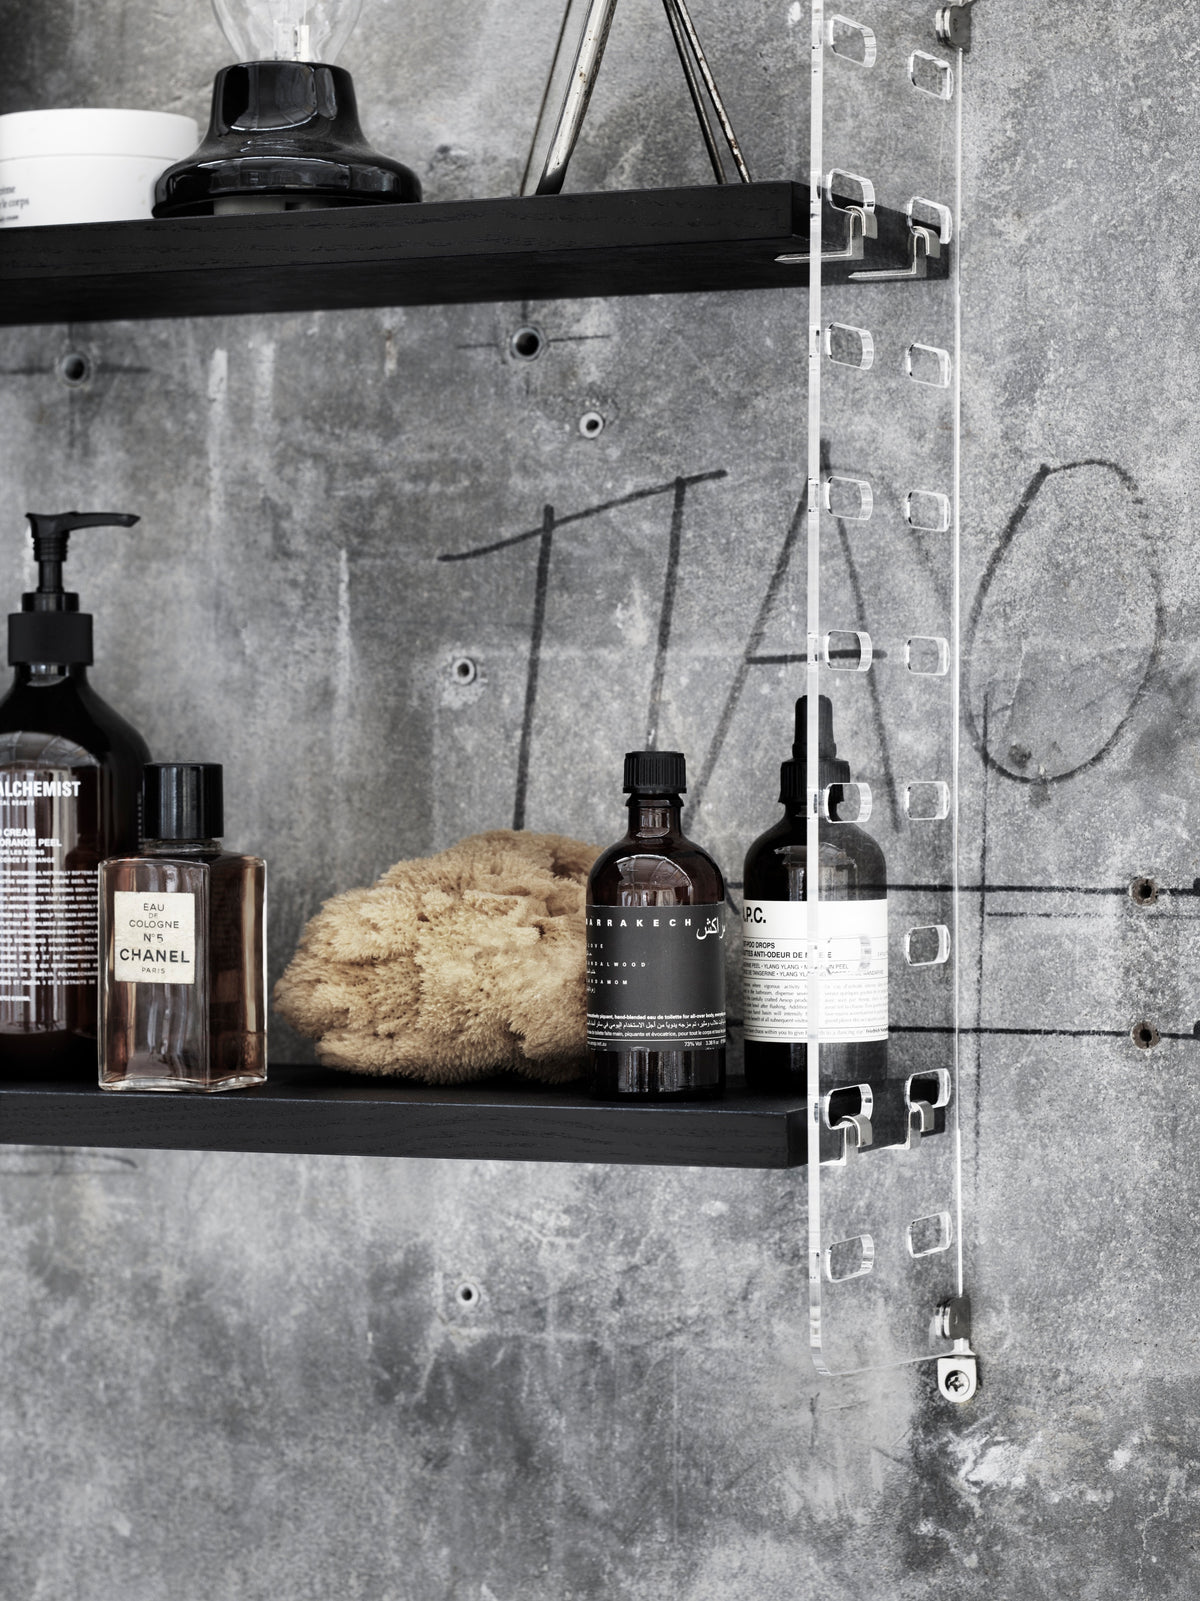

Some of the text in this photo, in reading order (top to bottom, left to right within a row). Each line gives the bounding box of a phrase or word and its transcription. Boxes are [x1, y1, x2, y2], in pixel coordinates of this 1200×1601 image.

[4, 828, 36, 838] CREAM
[0, 838, 62, 848] ORANGE PEEL
[143, 903, 165, 912] EAU
[129, 919, 180, 929] COLOGNE
[756, 941, 776, 949] DROPS
[119, 948, 191, 963] CHANEL
[754, 950, 791, 959] ANTI-ODEUR
[141, 967, 166, 975] PARIS
